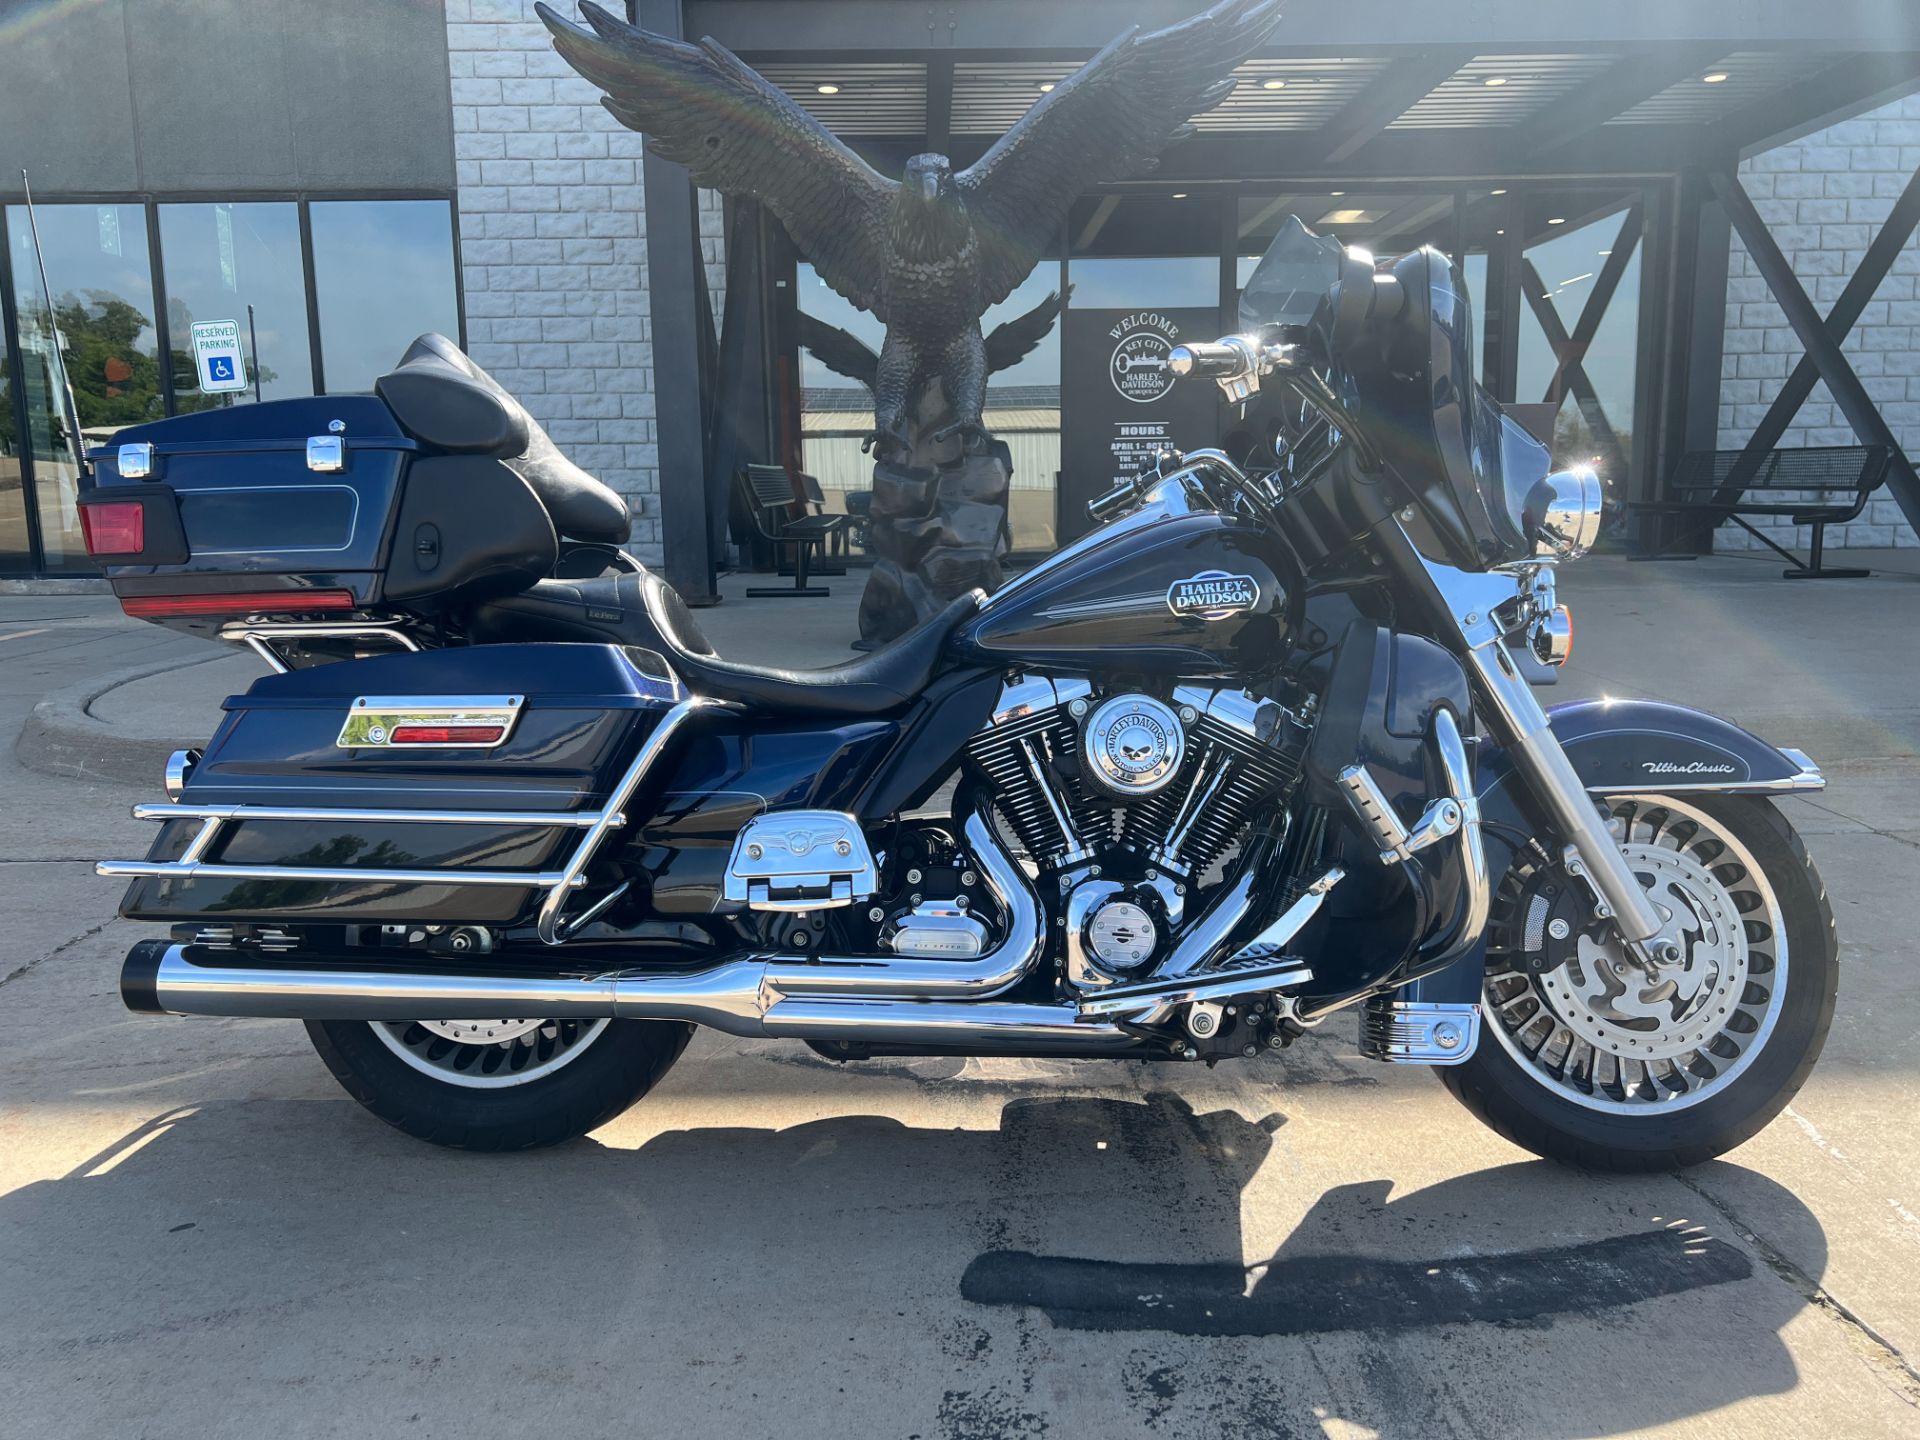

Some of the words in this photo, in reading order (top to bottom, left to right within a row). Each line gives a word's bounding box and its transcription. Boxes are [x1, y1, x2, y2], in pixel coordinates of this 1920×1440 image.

[1109, 312, 1179, 340] WELCOME
[195, 327, 236, 338] RESERVED
[200, 339, 235, 350] PARKING
[1125, 340, 1143, 352] KEY
[1144, 340, 1165, 352] CITY
[1126, 373, 1162, 381] HARLEY-
[1121, 380, 1164, 389] DAVIDSON
[1120, 426, 1164, 436] HOURS
[1146, 442, 1162, 450] OCT
[1181, 581, 1247, 596] HARLEY-
[1176, 591, 1253, 608] DAVIDSON
[1108, 716, 1165, 750] HARLEY-DAVIDSON
[1111, 753, 1162, 772] MOTORCYCLES
